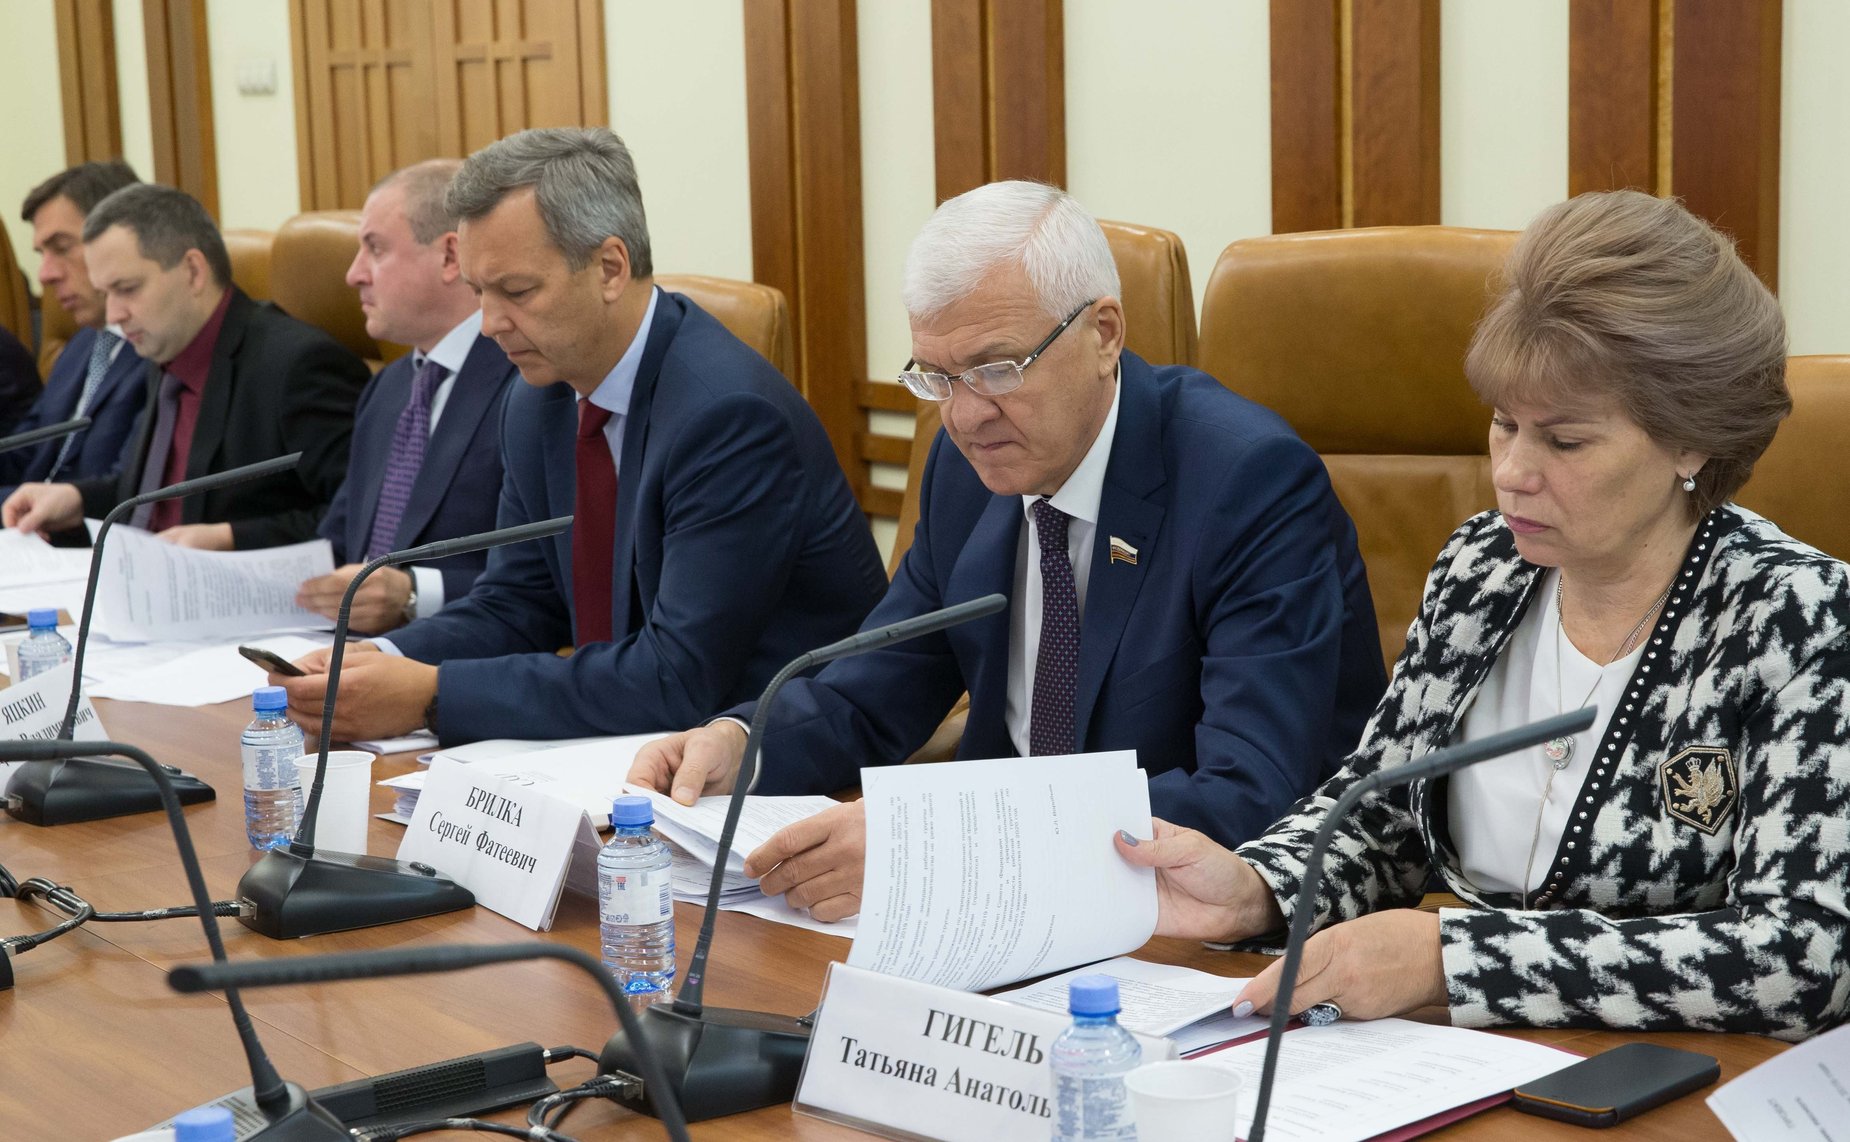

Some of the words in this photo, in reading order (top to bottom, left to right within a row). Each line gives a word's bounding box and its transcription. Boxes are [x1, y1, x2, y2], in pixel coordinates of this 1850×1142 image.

[1, 691, 46, 726] ЯЦКИН
[464, 786, 523, 828] БРИЛКА
[429, 811, 472, 845] Сергей
[476, 830, 538, 874] Фатеевич
[921, 1008, 1045, 1065] ГИГЕЛЬ
[840, 1036, 936, 1088] Татьяна
[943, 1066, 1052, 1119] Анатоль
